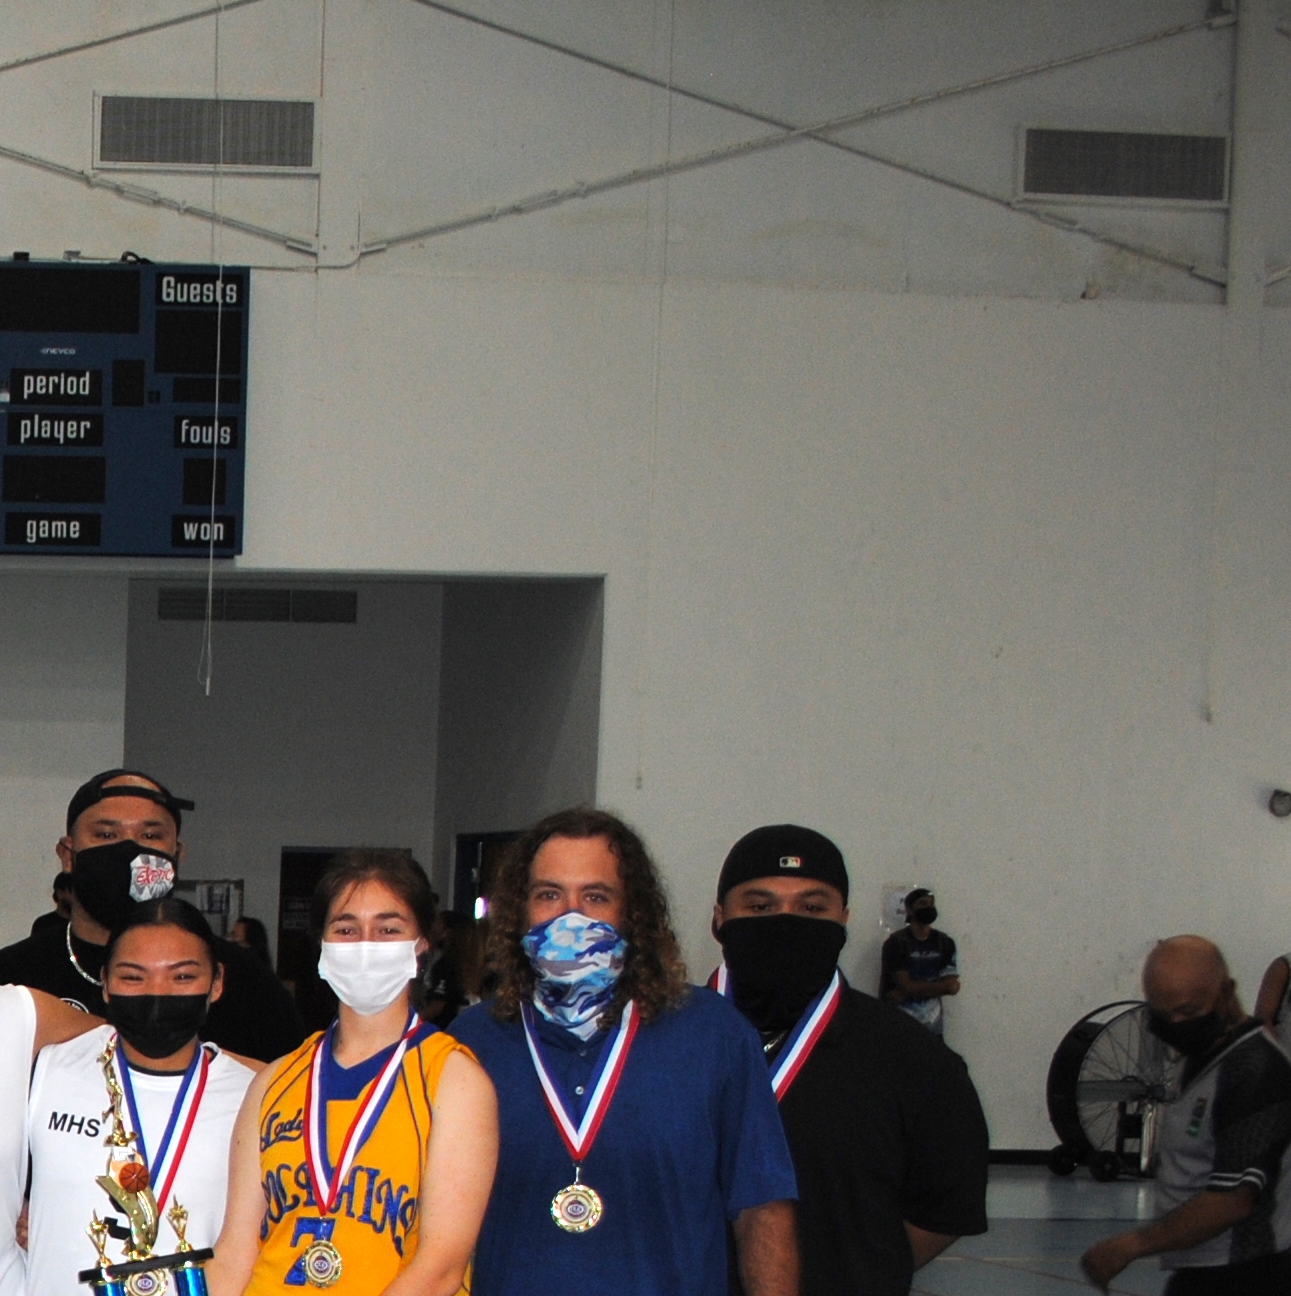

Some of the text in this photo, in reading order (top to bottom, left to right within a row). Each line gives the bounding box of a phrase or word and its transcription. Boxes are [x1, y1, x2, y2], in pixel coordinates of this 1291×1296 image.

[161, 277, 237, 304] Guests
[23, 372, 90, 398] period
[20, 414, 91, 444] player
[181, 420, 231, 445] fouls
[26, 520, 80, 544] game
[183, 520, 224, 542] won
[48, 1111, 101, 1137] MHS
